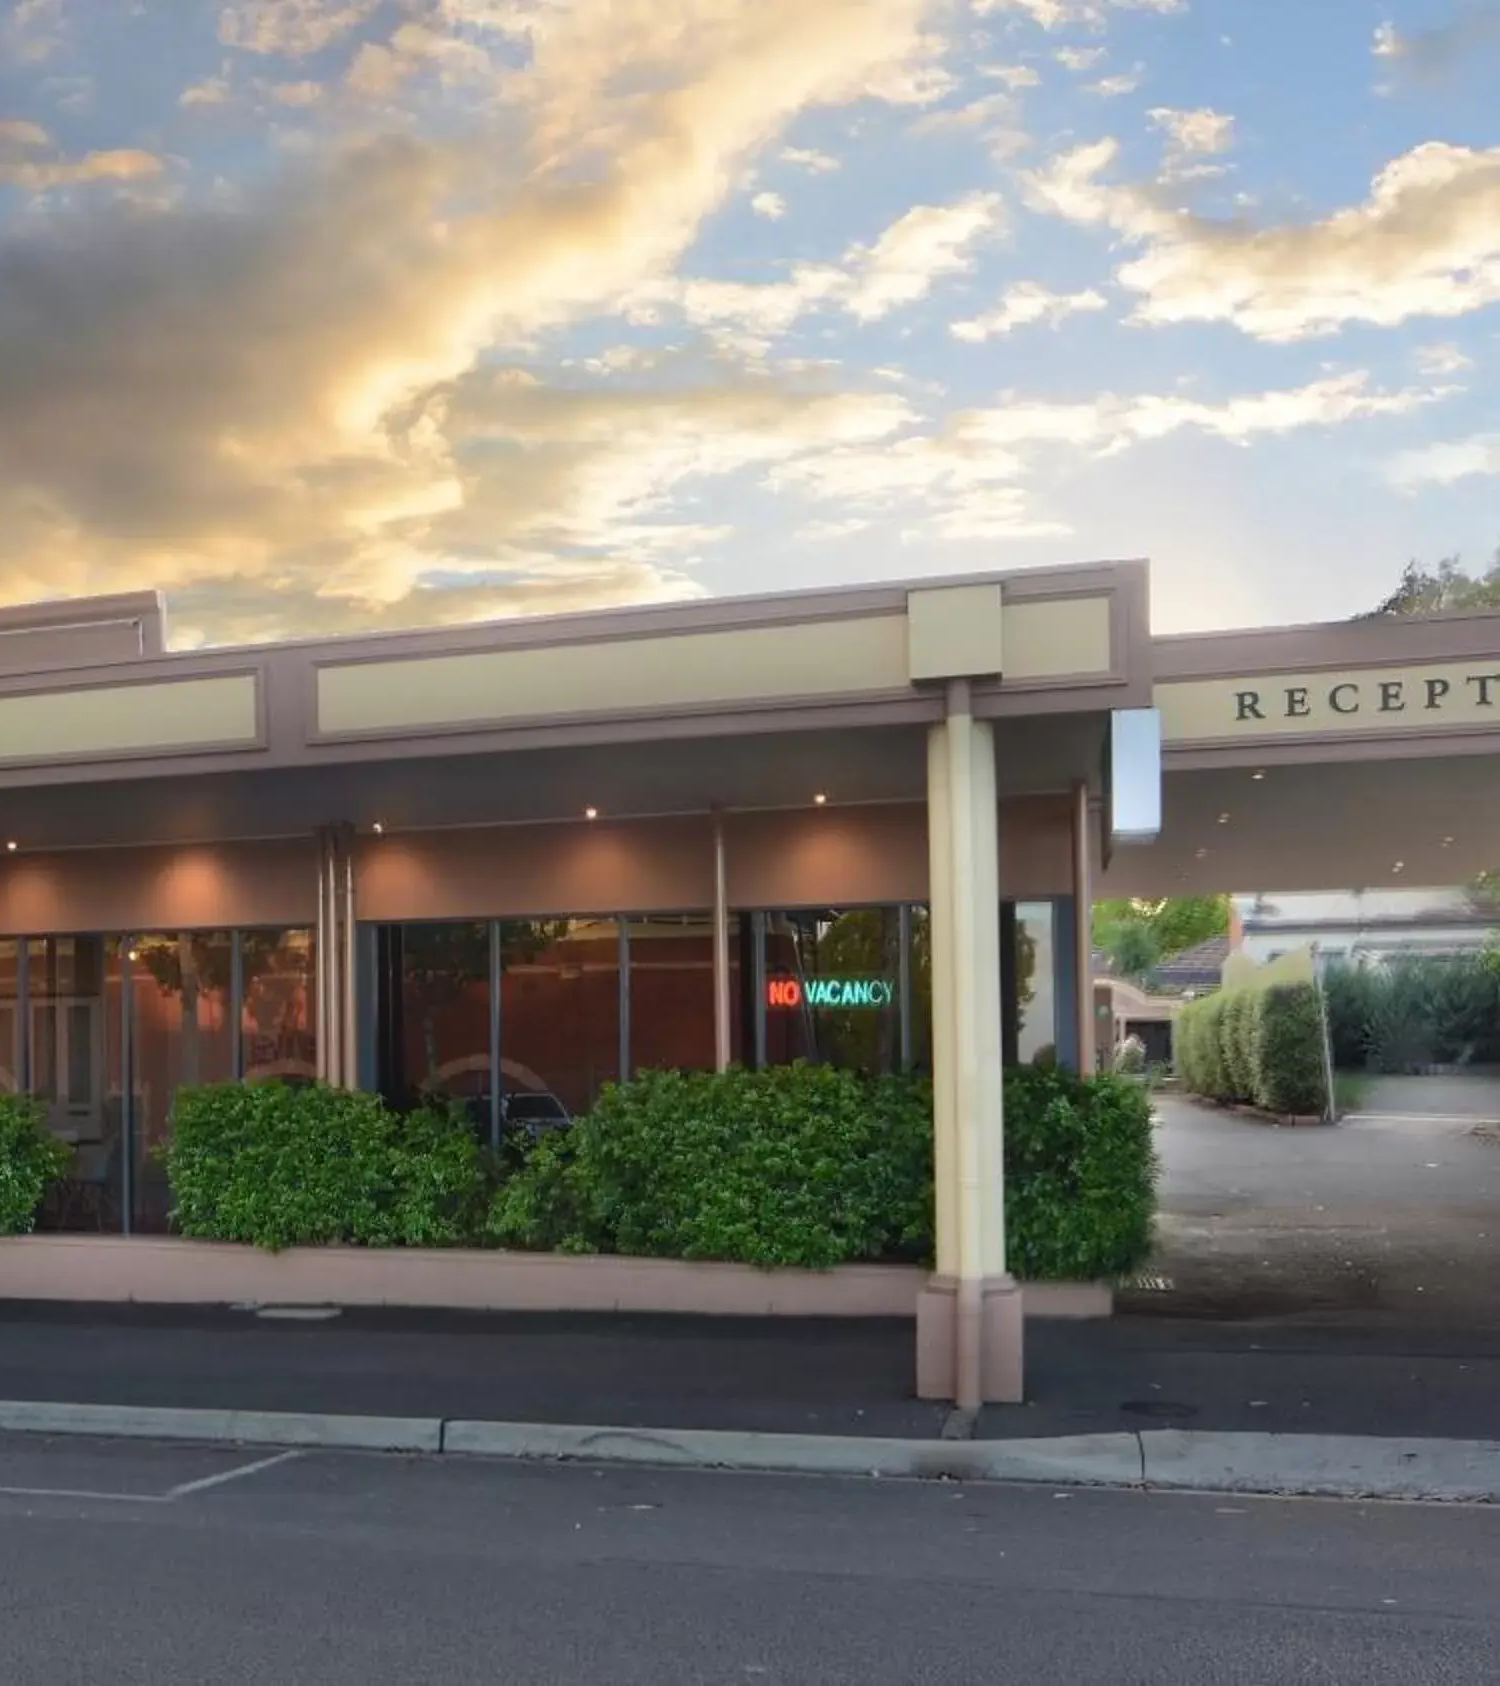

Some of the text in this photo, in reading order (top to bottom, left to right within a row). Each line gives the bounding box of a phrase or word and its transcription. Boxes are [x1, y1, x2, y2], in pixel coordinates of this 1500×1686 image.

[1234, 675, 1500, 721] RECEPT
[769, 979, 893, 1006] NO VACANCY
